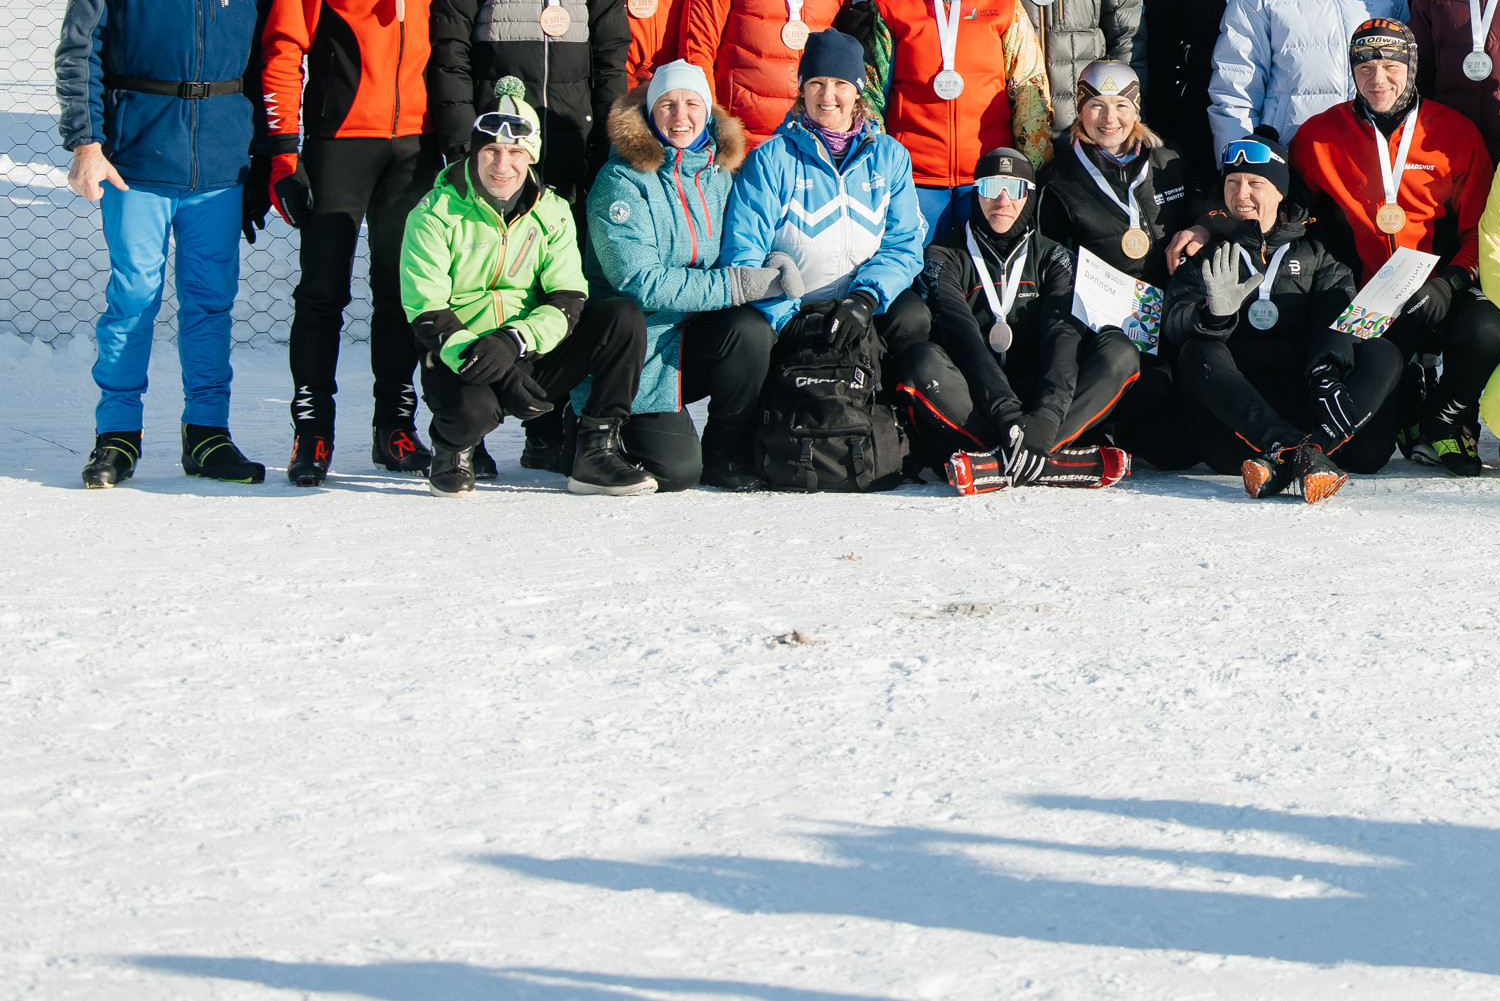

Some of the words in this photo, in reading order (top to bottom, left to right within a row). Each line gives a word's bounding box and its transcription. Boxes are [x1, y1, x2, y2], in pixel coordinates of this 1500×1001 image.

[1164, 185, 1184, 196] ТОМСКИЙ
[1084, 270, 1116, 295] ДИПЛОМ
[1394, 261, 1424, 300] ДИПЛОМ
[1406, 294, 1430, 314] NORDSKI
[1039, 474, 1101, 482] MADSHUS
